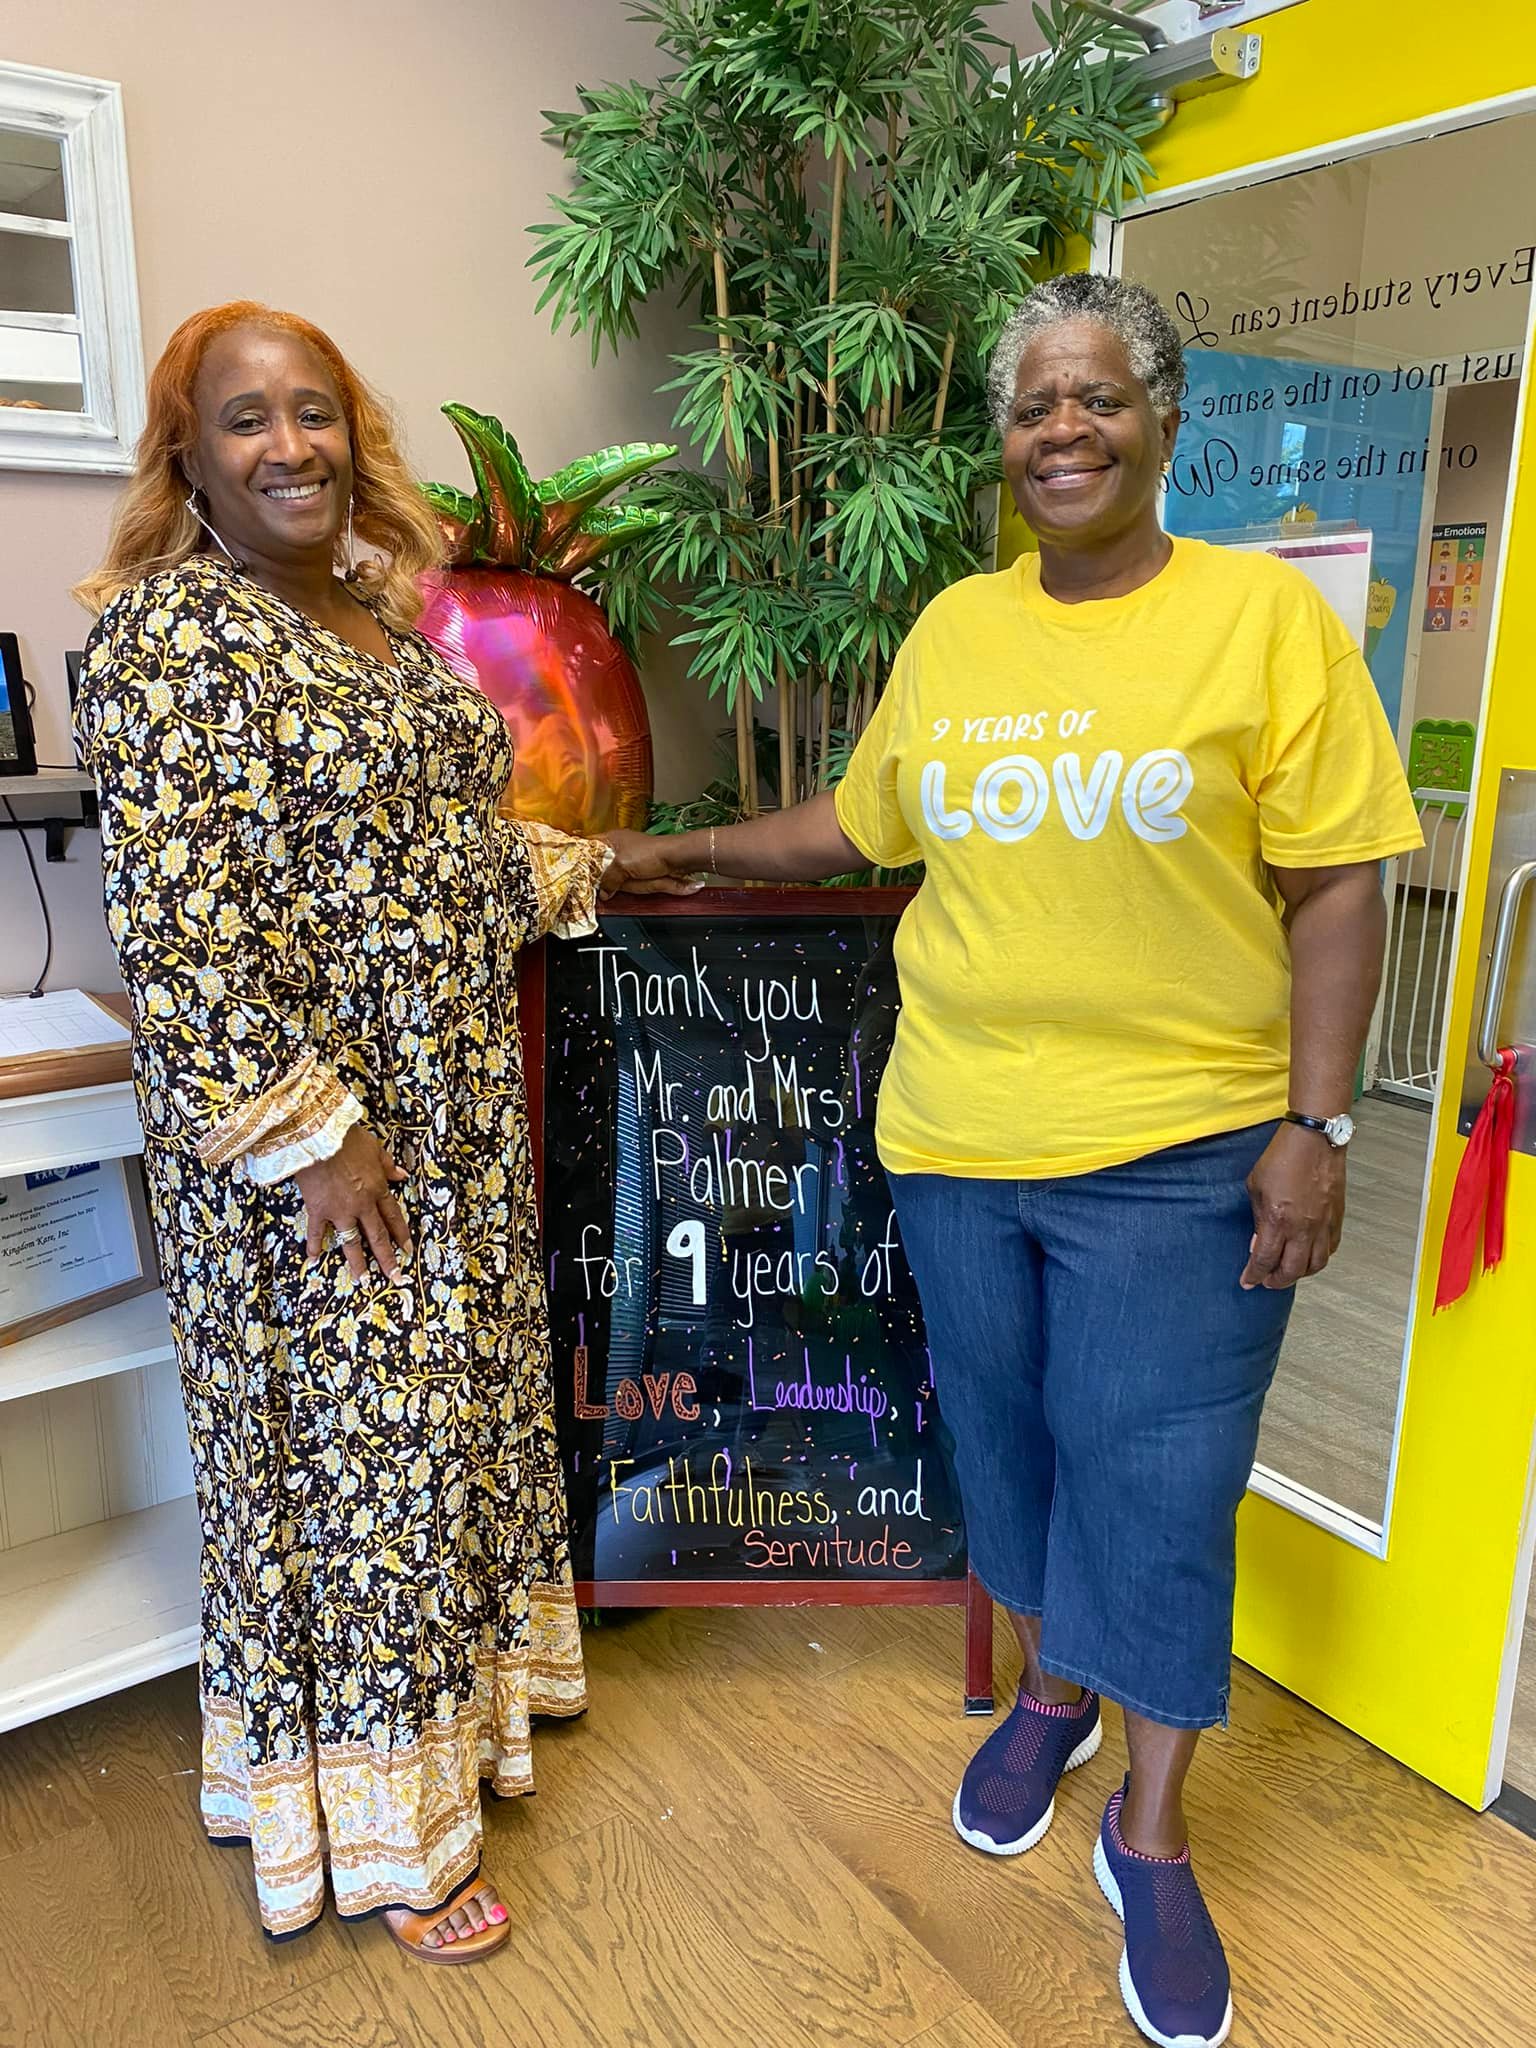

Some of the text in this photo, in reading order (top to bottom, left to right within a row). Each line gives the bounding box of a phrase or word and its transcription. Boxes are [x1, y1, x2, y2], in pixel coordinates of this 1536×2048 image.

[1444, 526, 1486, 537] Emotions
[931, 709, 1098, 743] 9 YEARS OF
[577, 946, 822, 1062] Thank you
[634, 1049, 689, 1122] Mr.
[707, 1060, 758, 1124] and
[653, 1129, 818, 1214] Palmer
[2, 1241, 35, 1257] Kingdom
[574, 1210, 898, 1328] for 9 years of
[857, 1458, 931, 1521] and
[744, 1525, 922, 1569] Servitude
